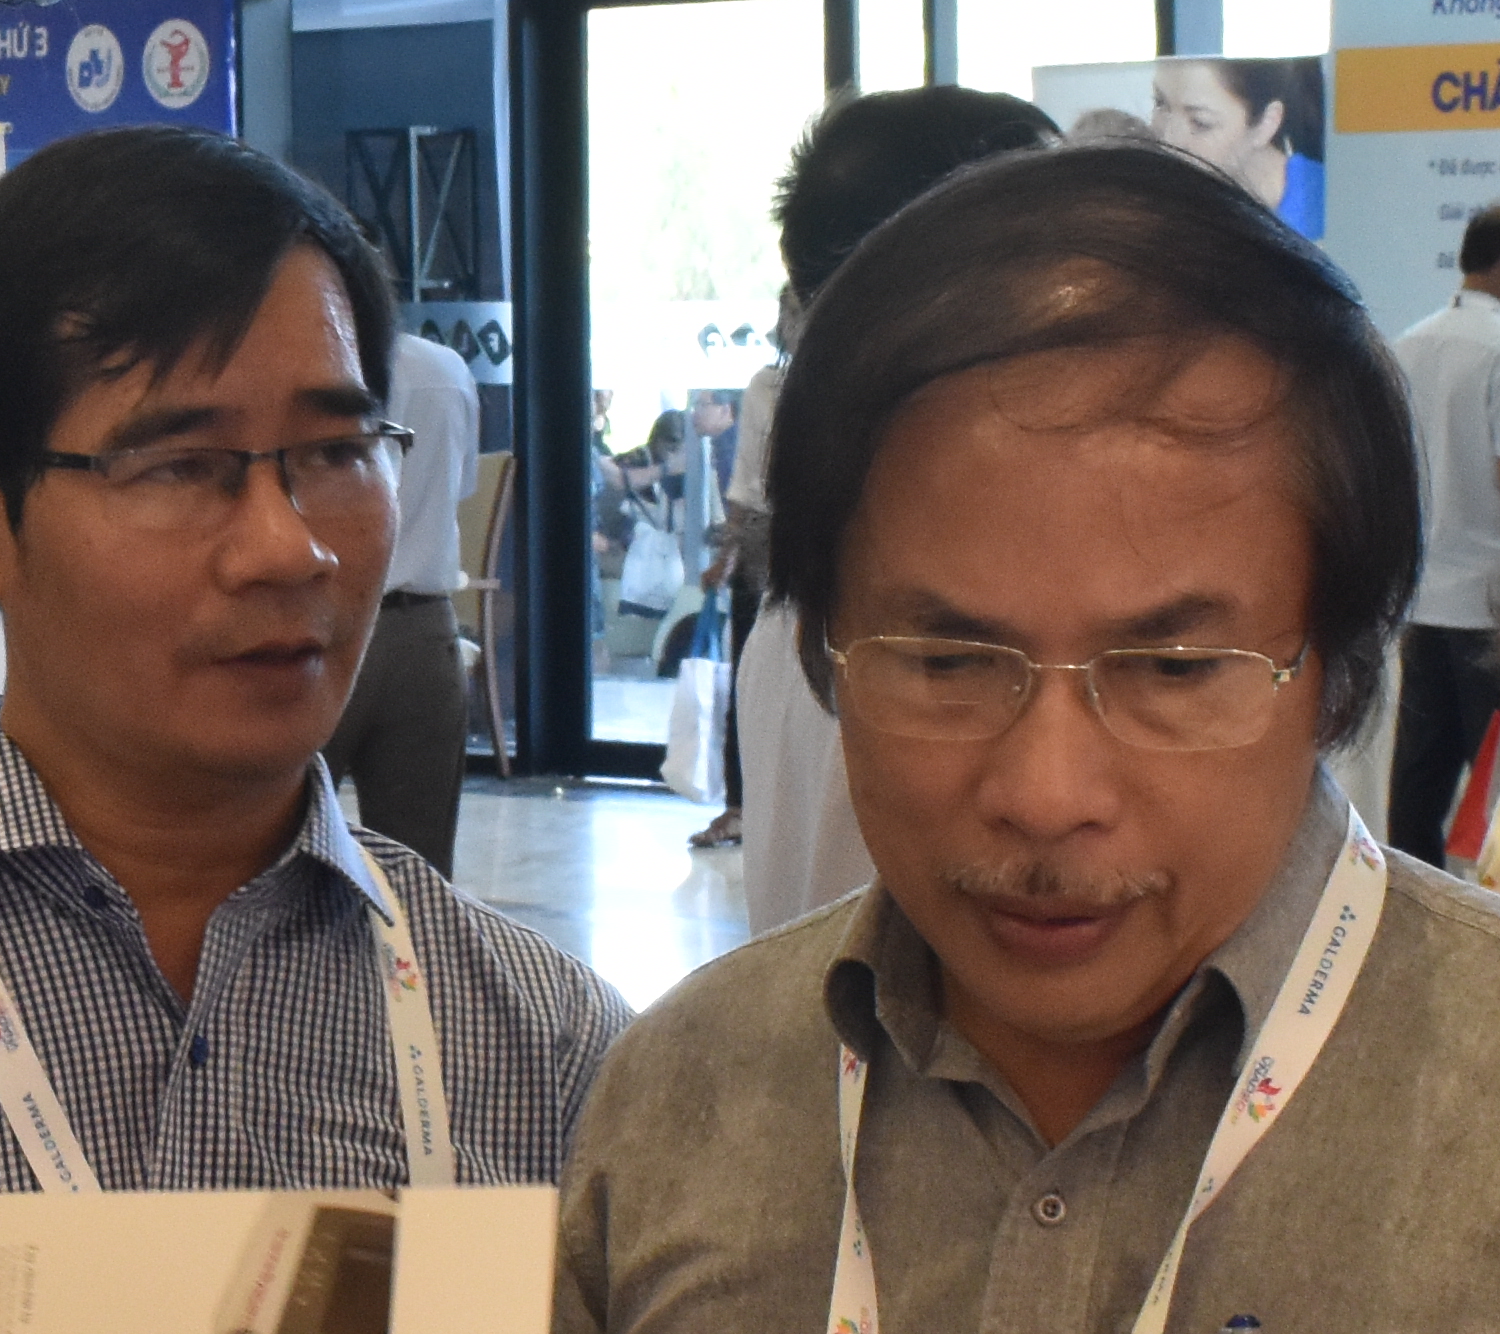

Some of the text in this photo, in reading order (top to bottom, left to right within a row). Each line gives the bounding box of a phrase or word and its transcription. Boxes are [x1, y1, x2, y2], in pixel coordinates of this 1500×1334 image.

[34, 26, 48, 58] 3
[1297, 924, 1347, 1016] GALDERMA
[23, 1090, 72, 1185] GALDERMA
[412, 1064, 433, 1157] GALDERMA
